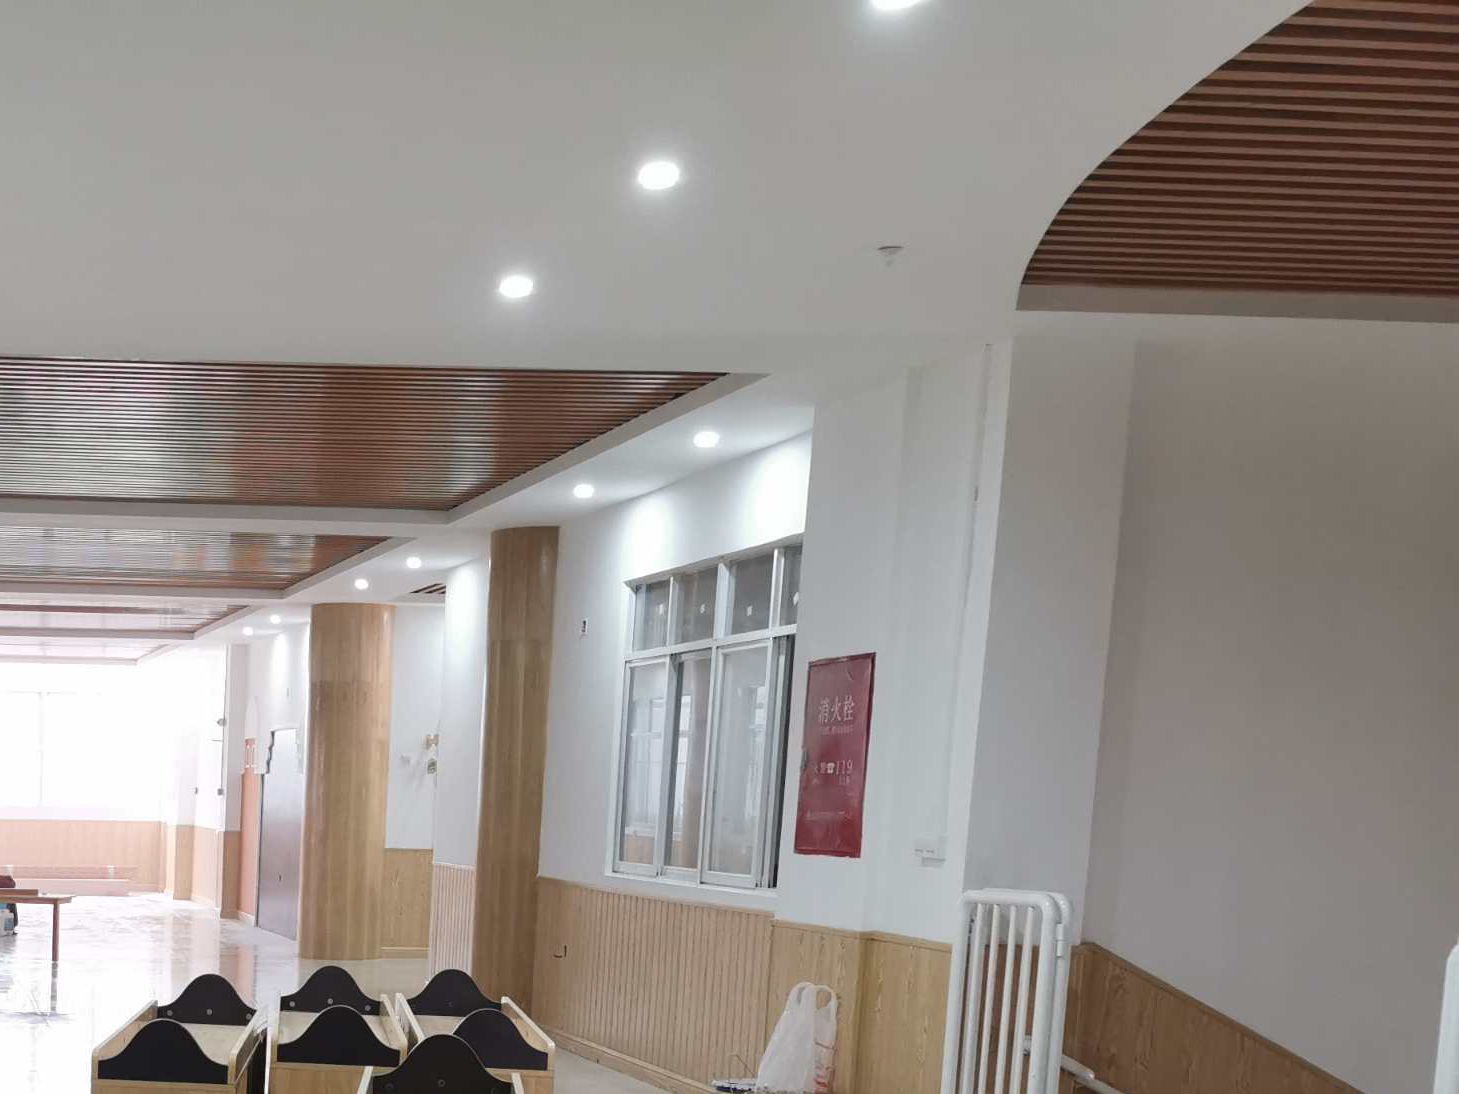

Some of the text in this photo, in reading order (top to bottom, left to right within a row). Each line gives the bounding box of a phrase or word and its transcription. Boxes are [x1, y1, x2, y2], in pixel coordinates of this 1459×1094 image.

[818, 695, 855, 724] 消火栓
[836, 759, 853, 775] 119
